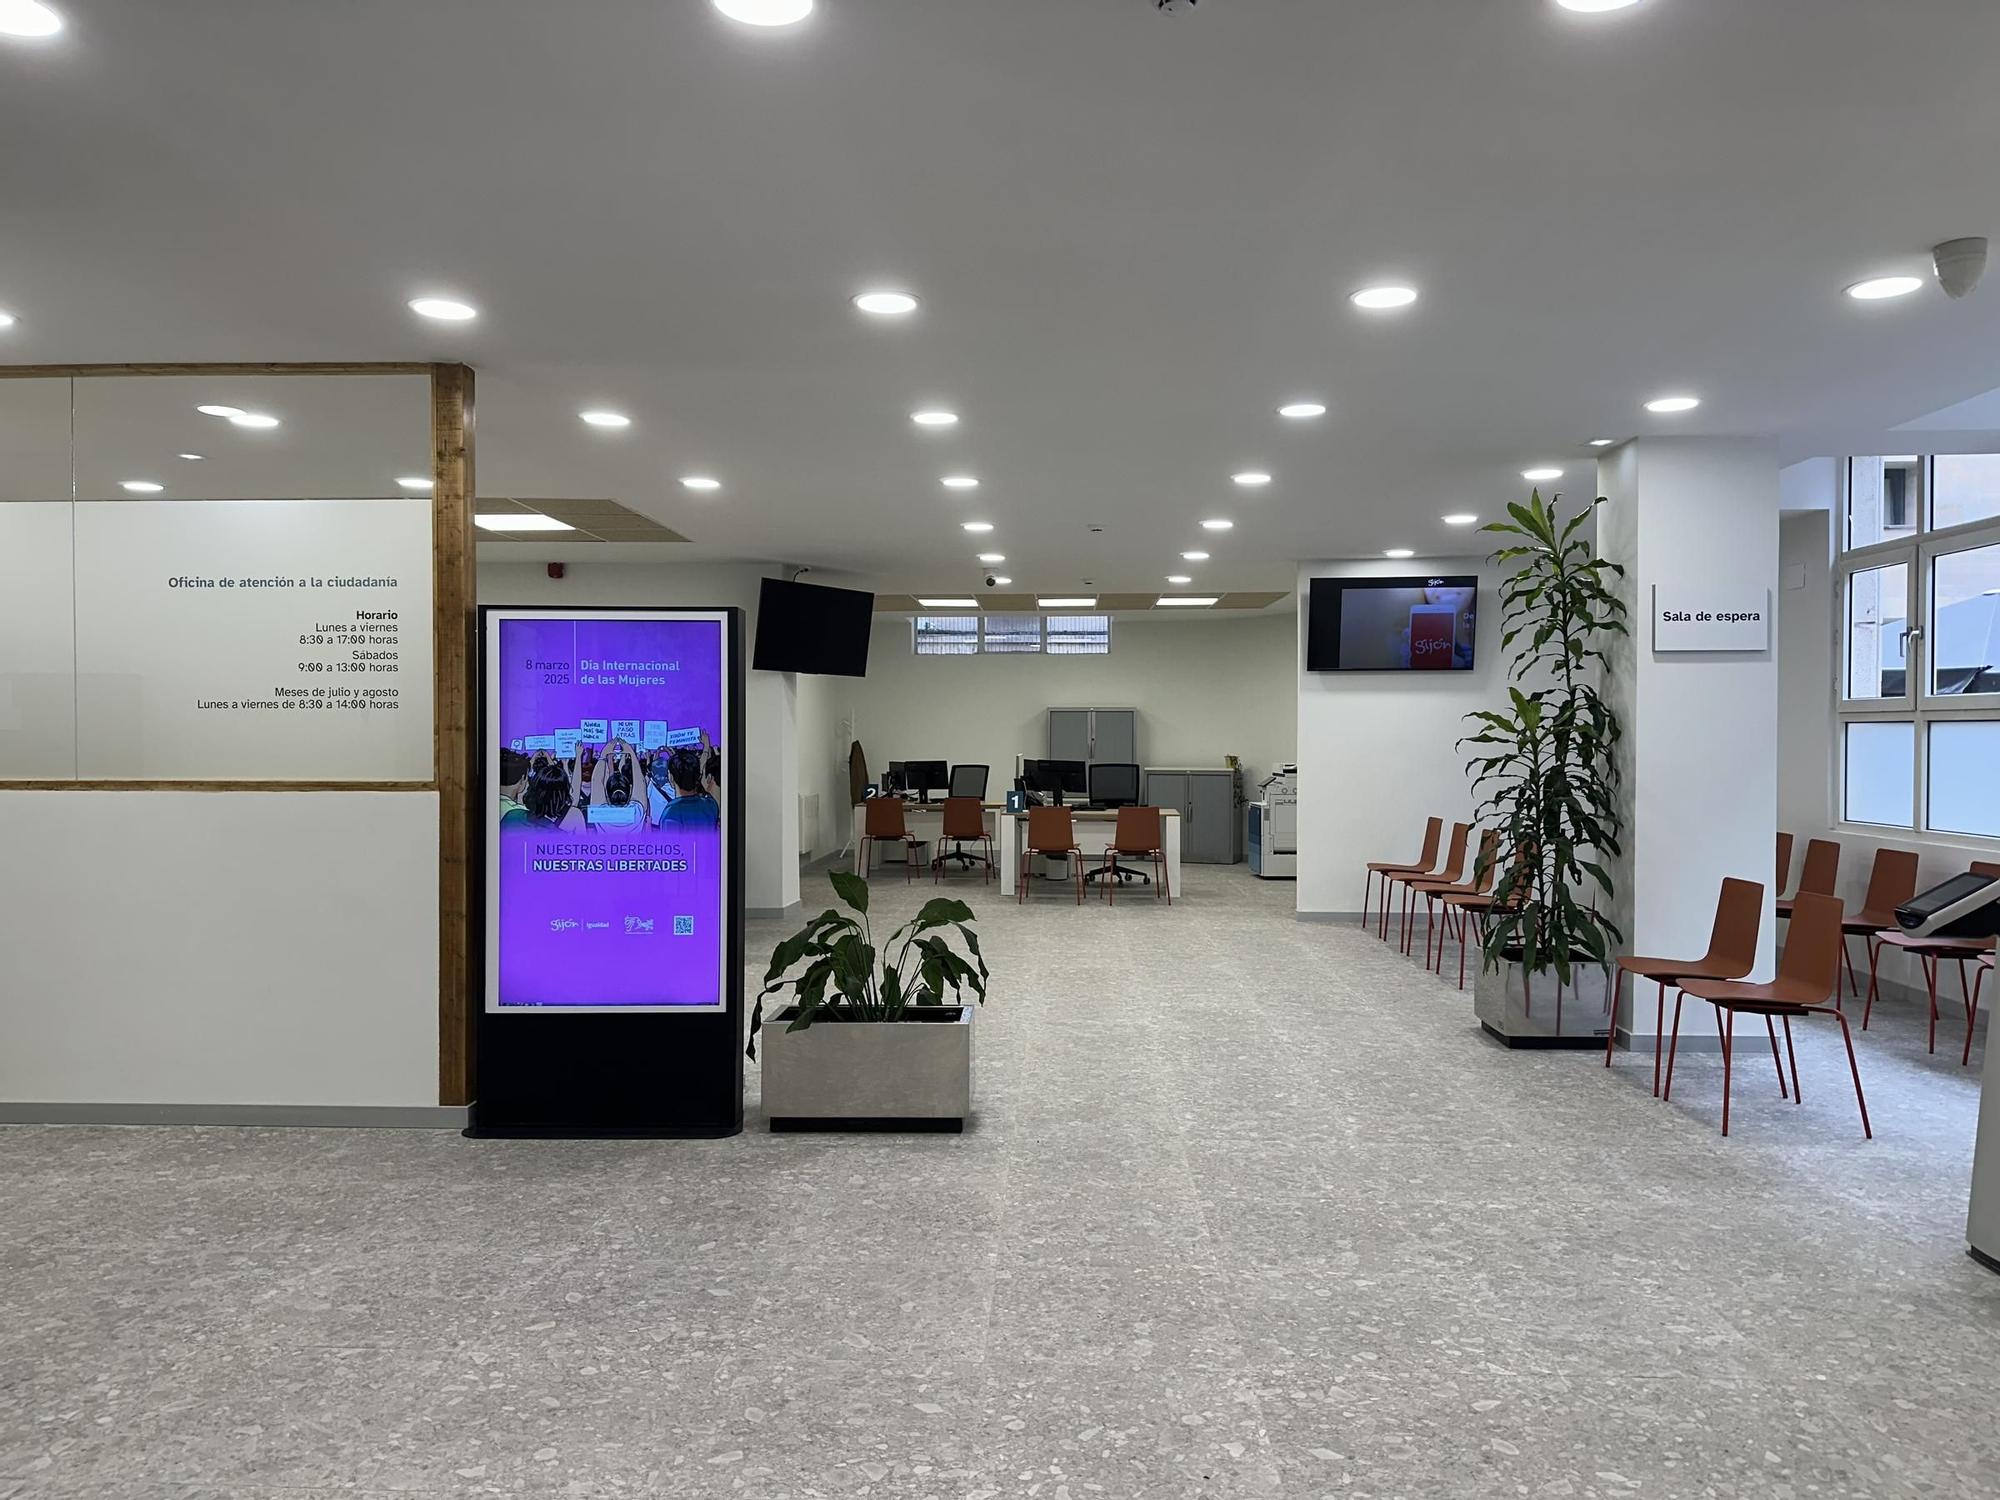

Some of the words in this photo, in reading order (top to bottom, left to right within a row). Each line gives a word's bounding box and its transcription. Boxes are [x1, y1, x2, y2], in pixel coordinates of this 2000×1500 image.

[168, 576, 214, 588] Oficina
[219, 576, 235, 588] de
[239, 576, 294, 588] atención
[299, 579, 306, 588] a
[311, 576, 323, 588] la
[327, 576, 398, 588] ciudadanía
[356, 610, 398, 620] Horario
[1663, 612, 1691, 622] Sala
[1696, 612, 1712, 621] de
[1716, 612, 1760, 623] espera
[315, 623, 347, 632] Lunes
[360, 623, 398, 632] viernes
[299, 635, 324, 645] 8:30
[327, 637, 333, 645] a
[336, 635, 366, 645] 17:00
[369, 635, 398, 645] horas
[352, 650, 398, 660] Sábados
[298, 663, 323, 673] 9:00
[326, 665, 333, 673] a
[336, 663, 366, 673] 13:00
[369, 663, 398, 673] horas
[525, 659, 533, 670] 8
[535, 661, 570, 670] marzo
[581, 659, 599, 671] Día
[603, 660, 681, 671] Internacional
[544, 674, 570, 685] 2025
[580, 674, 595, 685] de
[598, 674, 615, 685] las
[618, 674, 666, 687] Mujeres
[275, 687, 309, 697] Meses
[312, 687, 325, 697] de
[328, 687, 351, 699] julio
[354, 690, 360, 699] y
[362, 688, 399, 699] agosto
[197, 700, 229, 709] Lunes
[241, 700, 279, 709] viernes
[282, 700, 296, 709] de
[298, 700, 323, 709] 8:30
[336, 700, 366, 709] 14:00
[369, 700, 399, 709] horas
[866, 788, 877, 799] 2
[1011, 795, 1019, 809] 1
[536, 844, 607, 856] NUESTROS
[610, 844, 684, 857] DERECHOS,
[533, 860, 603, 871] NUESTRAS
[607, 860, 687, 871] LIBERTADES
